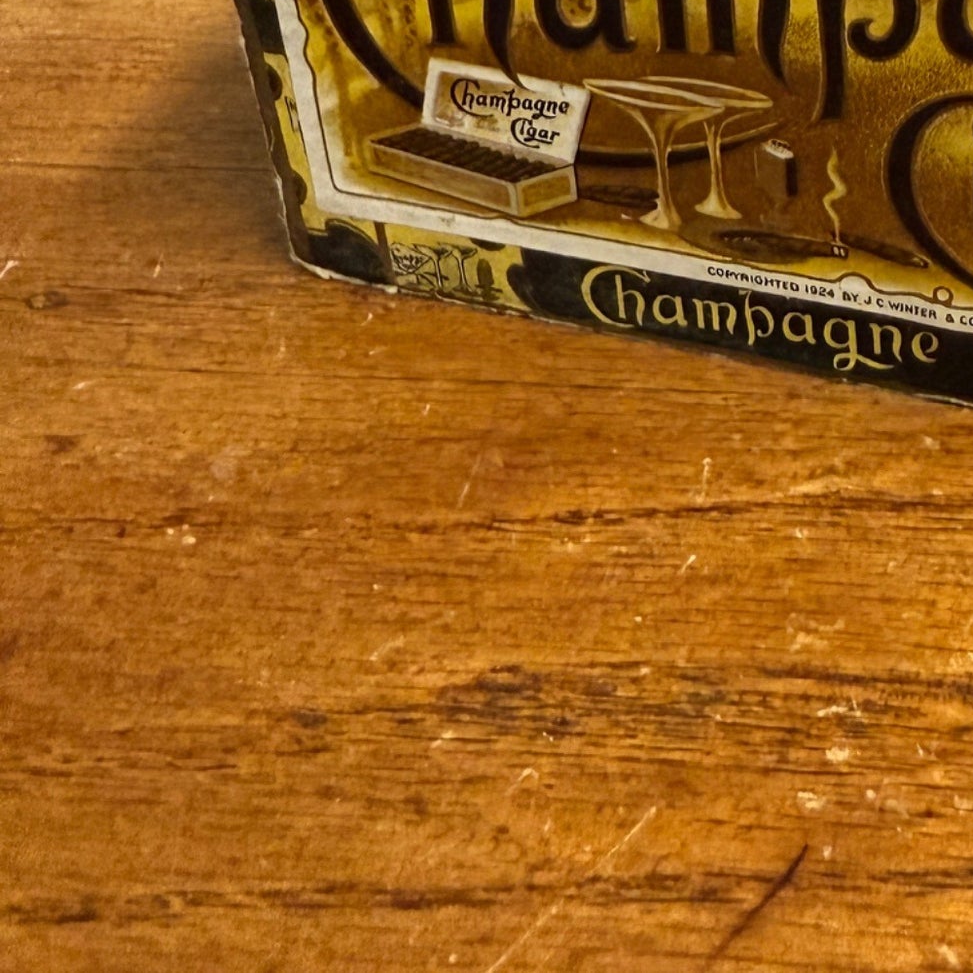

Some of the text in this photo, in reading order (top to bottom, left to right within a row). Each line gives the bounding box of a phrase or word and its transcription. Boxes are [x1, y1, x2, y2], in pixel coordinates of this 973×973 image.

[450, 78, 570, 120] Champagne
[510, 117, 560, 149] Cigar
[707, 266, 799, 292] COPYRIGHTED
[804, 284, 835, 299] 1924
[842, 291, 859, 303] BY
[888, 300, 937, 320] WINTER
[581, 265, 940, 370] Champagne
